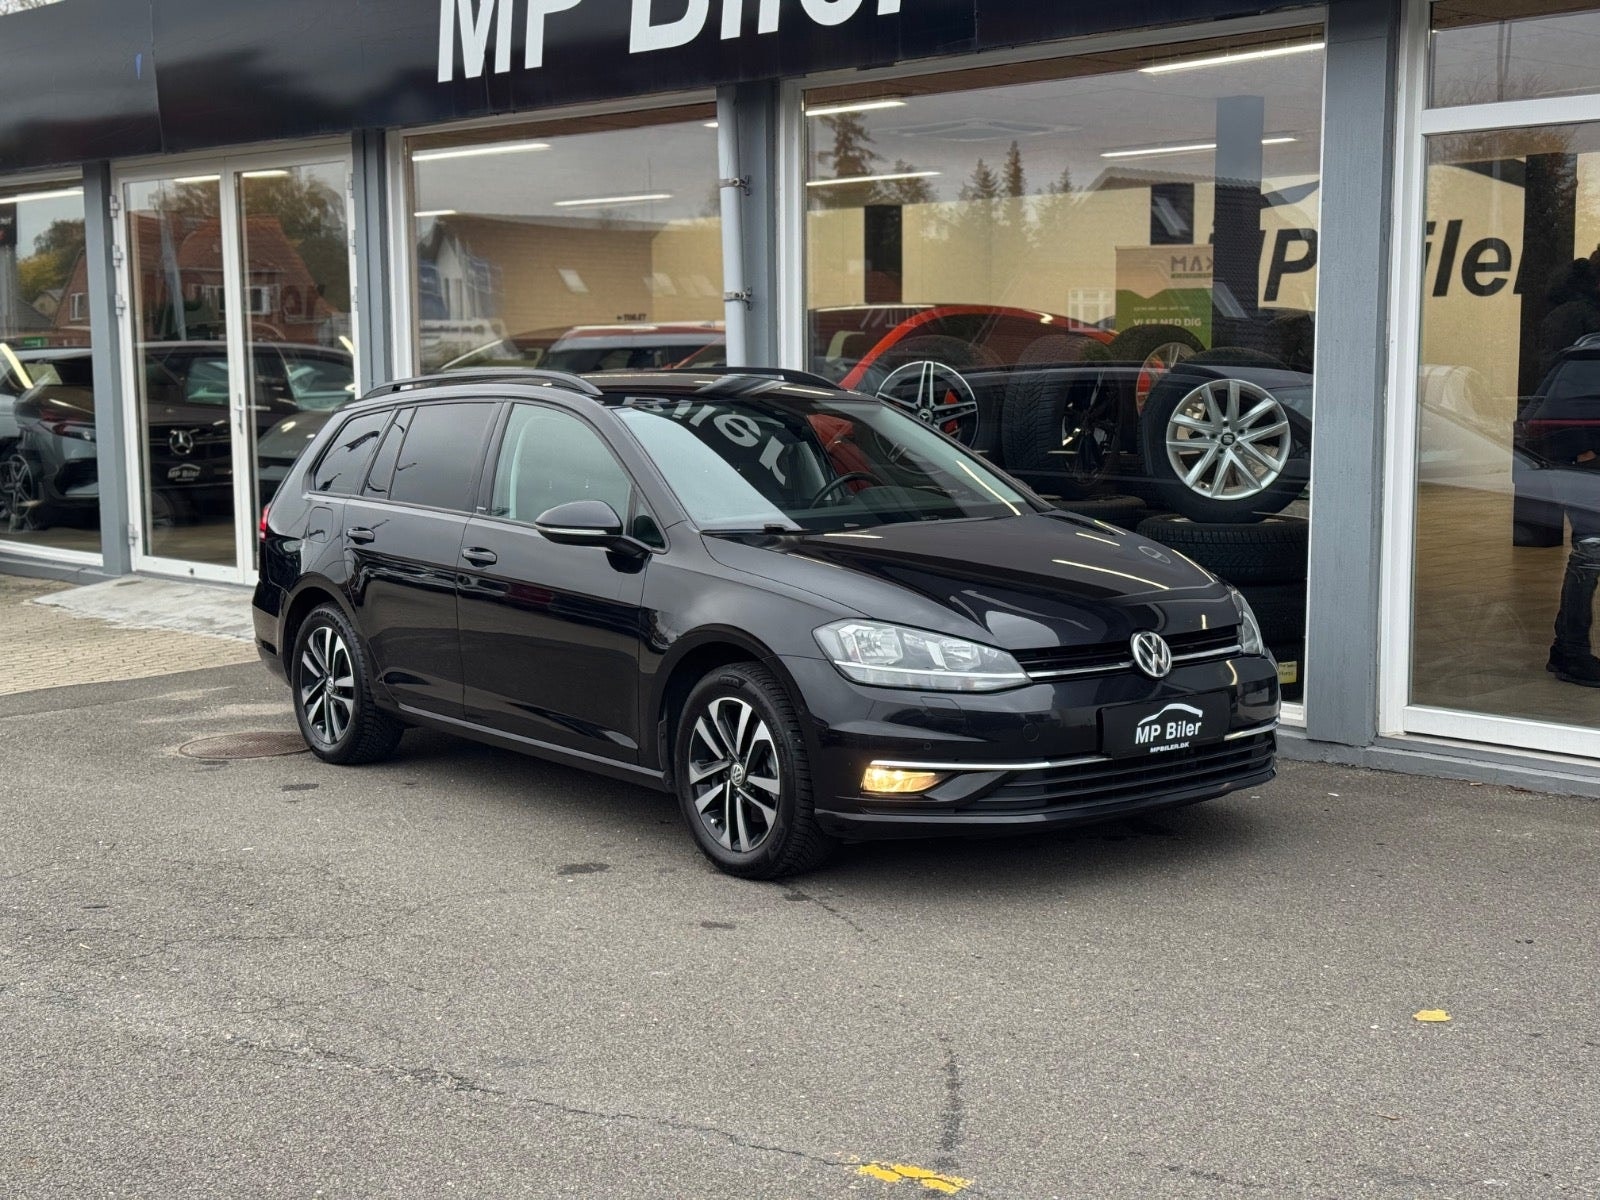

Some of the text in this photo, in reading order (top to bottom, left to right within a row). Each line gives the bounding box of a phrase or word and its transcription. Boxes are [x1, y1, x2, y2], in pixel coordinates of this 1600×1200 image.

[1257, 228, 1319, 301] P
[1184, 318, 1202, 327] DIG
[1135, 720, 1202, 744] MP Biler
[1149, 741, 1190, 753] MPBILER.DK
